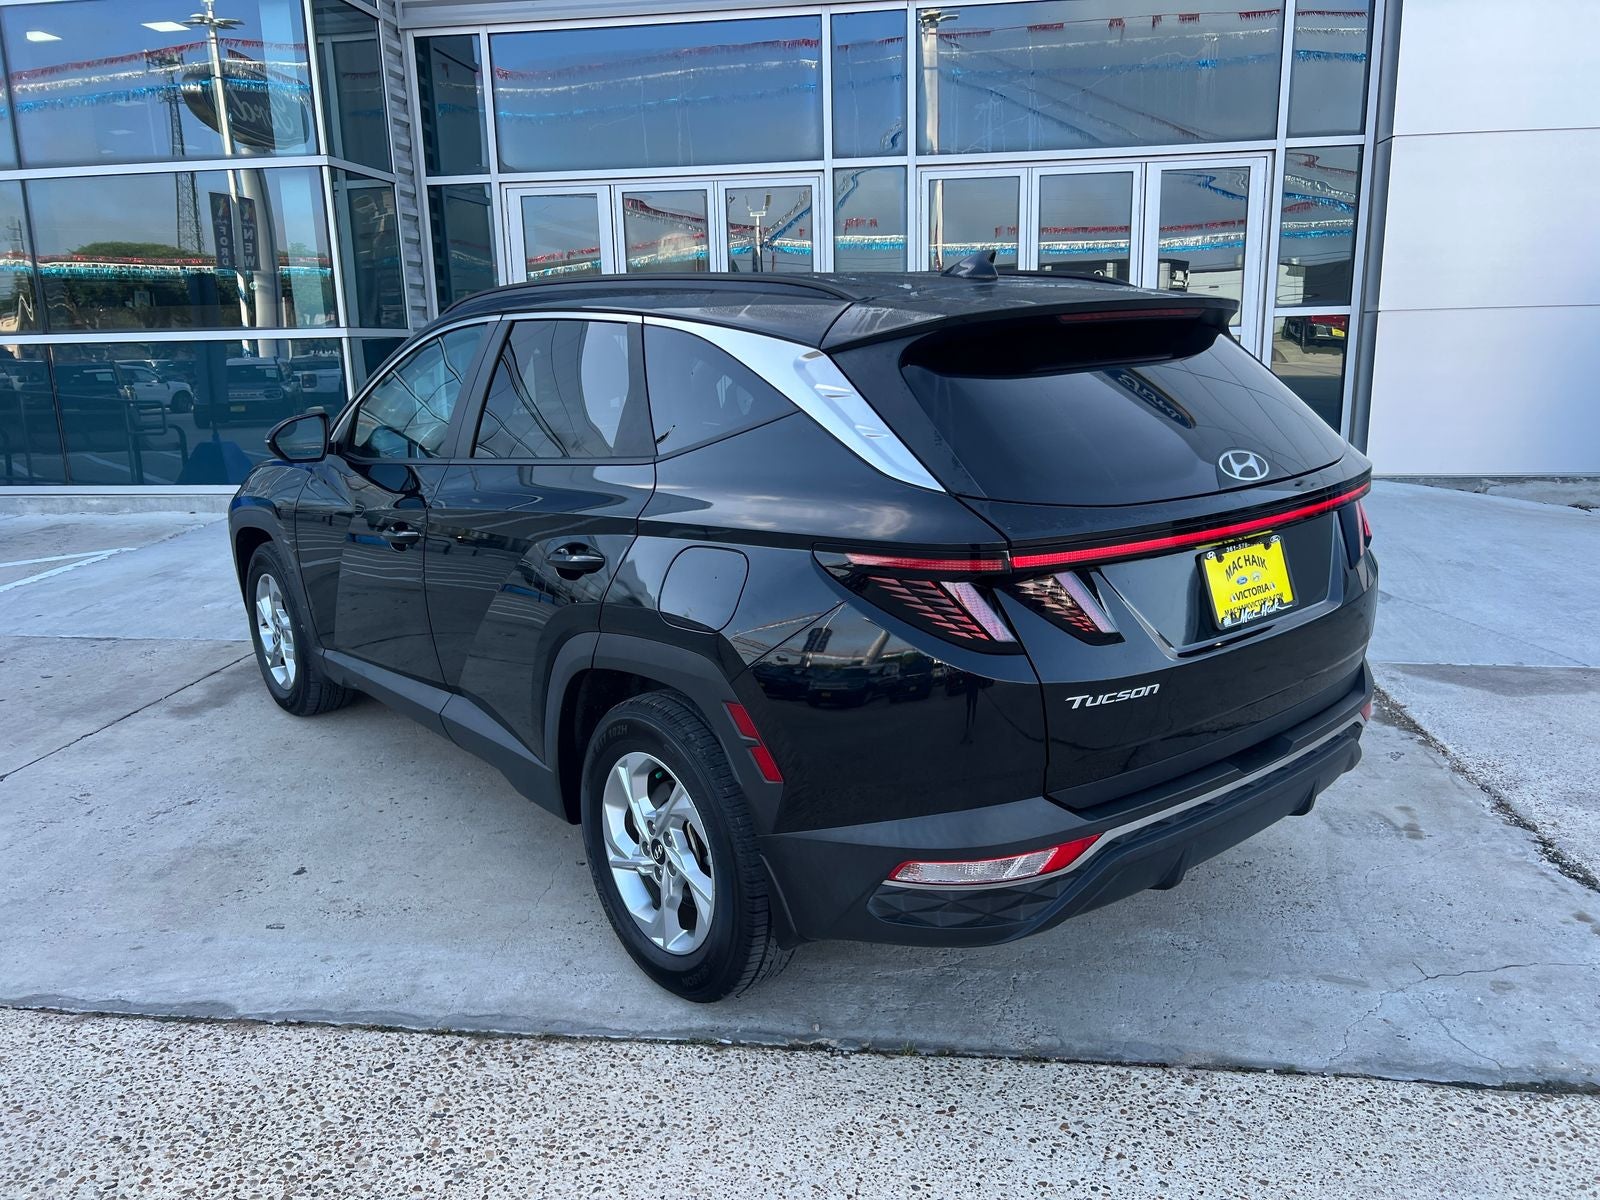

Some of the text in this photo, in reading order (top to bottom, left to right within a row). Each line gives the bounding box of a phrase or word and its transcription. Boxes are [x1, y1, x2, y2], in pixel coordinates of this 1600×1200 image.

[1225, 557, 1243, 581] MAC
[1243, 554, 1268, 570] HAIK
[1234, 583, 1270, 601] VICTORIA
[1240, 607, 1262, 623] Mac
